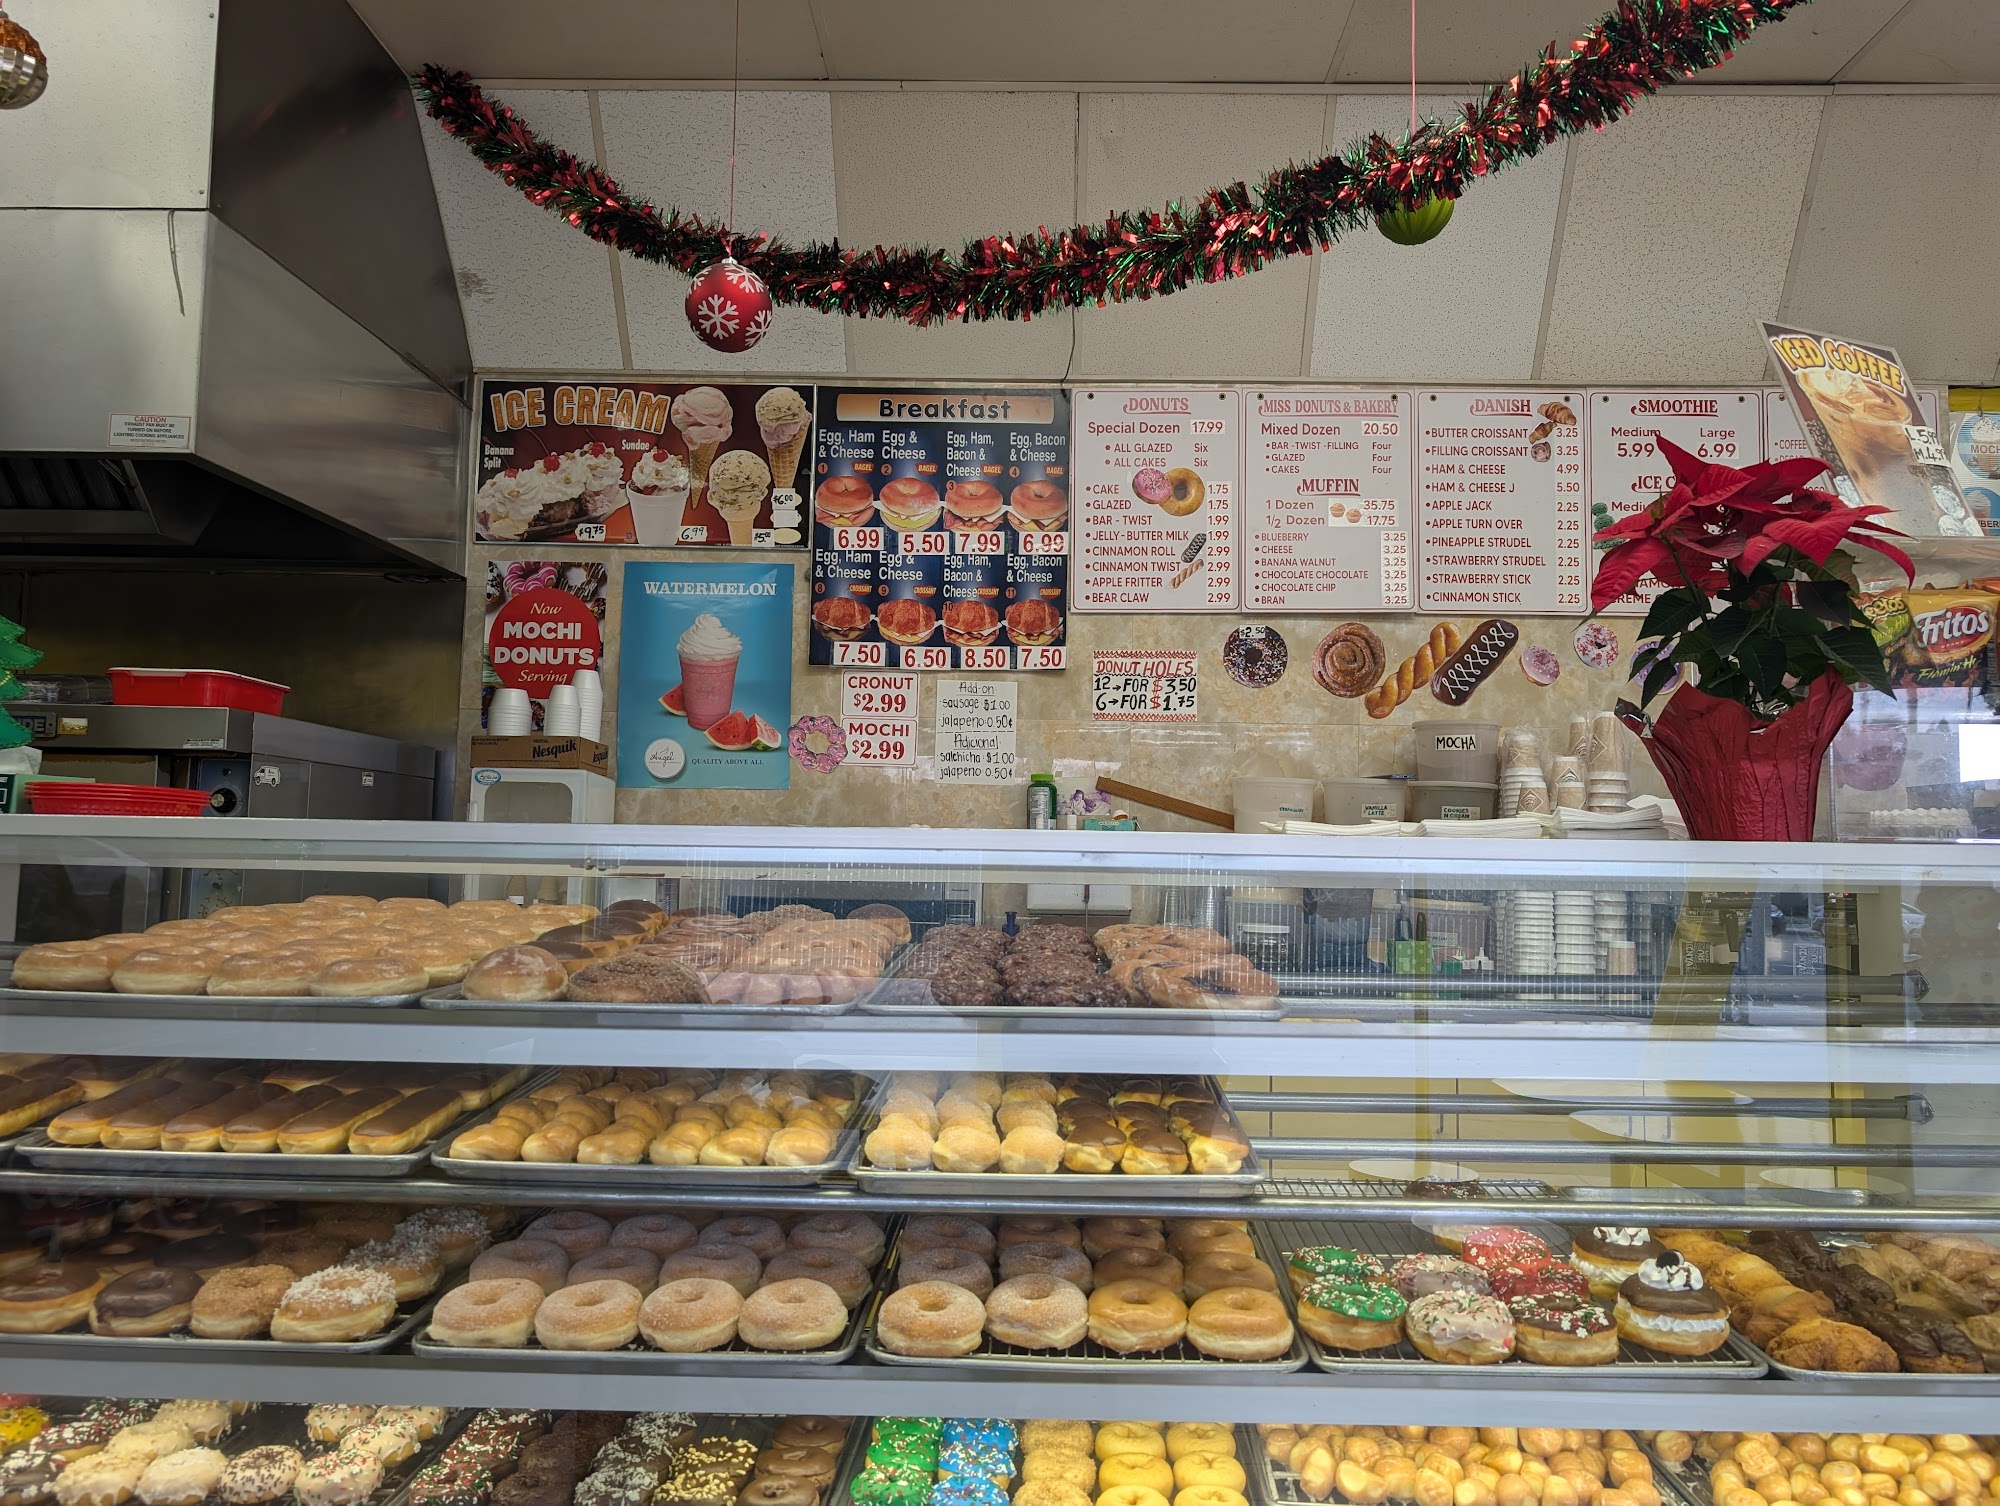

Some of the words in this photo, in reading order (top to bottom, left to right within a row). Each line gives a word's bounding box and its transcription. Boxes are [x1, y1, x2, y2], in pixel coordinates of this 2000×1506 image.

[1772, 337, 1826, 371] ICED
[1823, 339, 1906, 394] COFFEE
[490, 387, 546, 433] ICE
[554, 385, 671, 435] CREAM
[879, 398, 1011, 419] Breakfast
[1129, 398, 1189, 411] DONUTS
[1264, 399, 1291, 413] MISS
[1295, 399, 1341, 413] DONUTS
[1343, 401, 1351, 412] &
[1354, 399, 1399, 413] BAKERY
[1475, 399, 1531, 412] DANISH
[1638, 400, 1718, 413] SMOOTHIE
[1088, 422, 1135, 436] Special
[1139, 422, 1180, 433] Dozen
[1192, 421, 1223, 433] 17.99
[1261, 423, 1298, 435] Mixed
[1302, 424, 1340, 435] Dozen
[1363, 423, 1398, 434] 20.50
[1431, 428, 1468, 438] BUTTER
[1471, 428, 1528, 439] CROISSANT
[1556, 428, 1578, 438] 3.25
[1611, 427, 1661, 437] Medium
[1700, 428, 1735, 440] Large
[819, 429, 845, 444] Egg,
[848, 430, 875, 443] Ham
[882, 430, 905, 445] Egg
[909, 431, 918, 443] &
[947, 431, 968, 447] Egg,
[970, 432, 994, 447] Ham,
[1010, 432, 1032, 447] Egg,
[1035, 433, 1066, 445] Bacon
[484, 444, 514, 456] Banana
[621, 439, 650, 451] Sundae
[1114, 444, 1131, 453] ALL
[1134, 443, 1173, 453] GLAZED
[1194, 443, 1208, 453] Six
[1617, 442, 1655, 458] 5.99
[1697, 443, 1737, 458] 6.99
[1780, 440, 1807, 449] COFFEE
[818, 446, 827, 458] &
[830, 446, 874, 459] Cheese
[882, 447, 926, 459] Cheese
[946, 448, 976, 460] Bacon
[979, 449, 986, 460] &
[1009, 449, 1017, 461] &
[1020, 449, 1056, 461] Cheese
[484, 457, 501, 469] Split
[946, 464, 981, 476] Cheese
[1301, 479, 1359, 492] MUFFIN
[1431, 482, 1455, 492] HAM
[1458, 483, 1465, 492] &
[1469, 483, 1506, 492] CHEESE
[1509, 483, 1515, 492] J
[1556, 482, 1580, 492] 5.50
[1638, 476, 1662, 489] ICE
[1093, 485, 1119, 494] CAKE
[1208, 485, 1229, 494] 1.75
[1093, 500, 1132, 509] GLAZED
[1208, 500, 1229, 509] 1.75
[1266, 500, 1271, 509] 1
[1276, 500, 1314, 509] Dozen
[1363, 500, 1395, 510] 35.75
[1432, 501, 1463, 511] APPLE
[1466, 501, 1492, 511] JACK
[1557, 502, 1579, 512] 2.25
[1286, 515, 1325, 525] Dozen
[1367, 516, 1395, 526] 17.75
[578, 525, 605, 539] $9.75
[1166, 531, 1189, 541] MILK
[1208, 531, 1229, 541] 1.99
[1261, 533, 1309, 541] BLUEBERRY
[1383, 533, 1406, 541] 3.25
[838, 529, 880, 549] 6.99
[903, 534, 945, 553] 5.50
[959, 533, 1001, 553] 7.99
[1023, 533, 1064, 553] 6.99
[1092, 547, 1148, 556] CINNAMON
[1151, 547, 1176, 556] ROLL
[1207, 547, 1230, 556] 2.99
[1432, 556, 1499, 566] STRAWBERRY
[1502, 556, 1546, 566] STRUDEL
[1558, 557, 1580, 567] 2.25
[1262, 571, 1313, 579] CHOCOLATE
[1316, 571, 1368, 579] CHOCOLATE
[1384, 570, 1407, 579] 3.25
[644, 582, 777, 596] WATERMELON
[1433, 592, 1490, 602] CINNAMON
[1492, 593, 1521, 603] STICK
[1558, 593, 1580, 604] 2.25
[530, 603, 562, 614] Now
[503, 622, 581, 640] MOCHI
[1914, 608, 1989, 648] Fritos
[494, 647, 594, 665] DONUTS
[839, 644, 881, 663] 7.50
[904, 649, 947, 668] 6.50
[964, 649, 1006, 668] 8.50
[1021, 649, 1062, 667] 7.50
[1096, 660, 1140, 673] DONUT
[1143, 660, 1193, 678] HOLES
[518, 669, 568, 685] Serving
[848, 676, 913, 690] CRONUT
[1094, 676, 1110, 691] 12
[1123, 678, 1149, 692] FOR
[854, 692, 906, 712] $2.99
[984, 699, 1010, 711] $1.00
[1096, 693, 1106, 711] 6
[1120, 694, 1147, 710] FOR
[849, 723, 909, 737] MOCHI
[532, 740, 576, 758] Nesquik
[1436, 735, 1476, 750] MOCHA
[852, 739, 904, 760] $2.99
[691, 758, 723, 766] QUALITY
[986, 752, 1014, 764] $1.00
